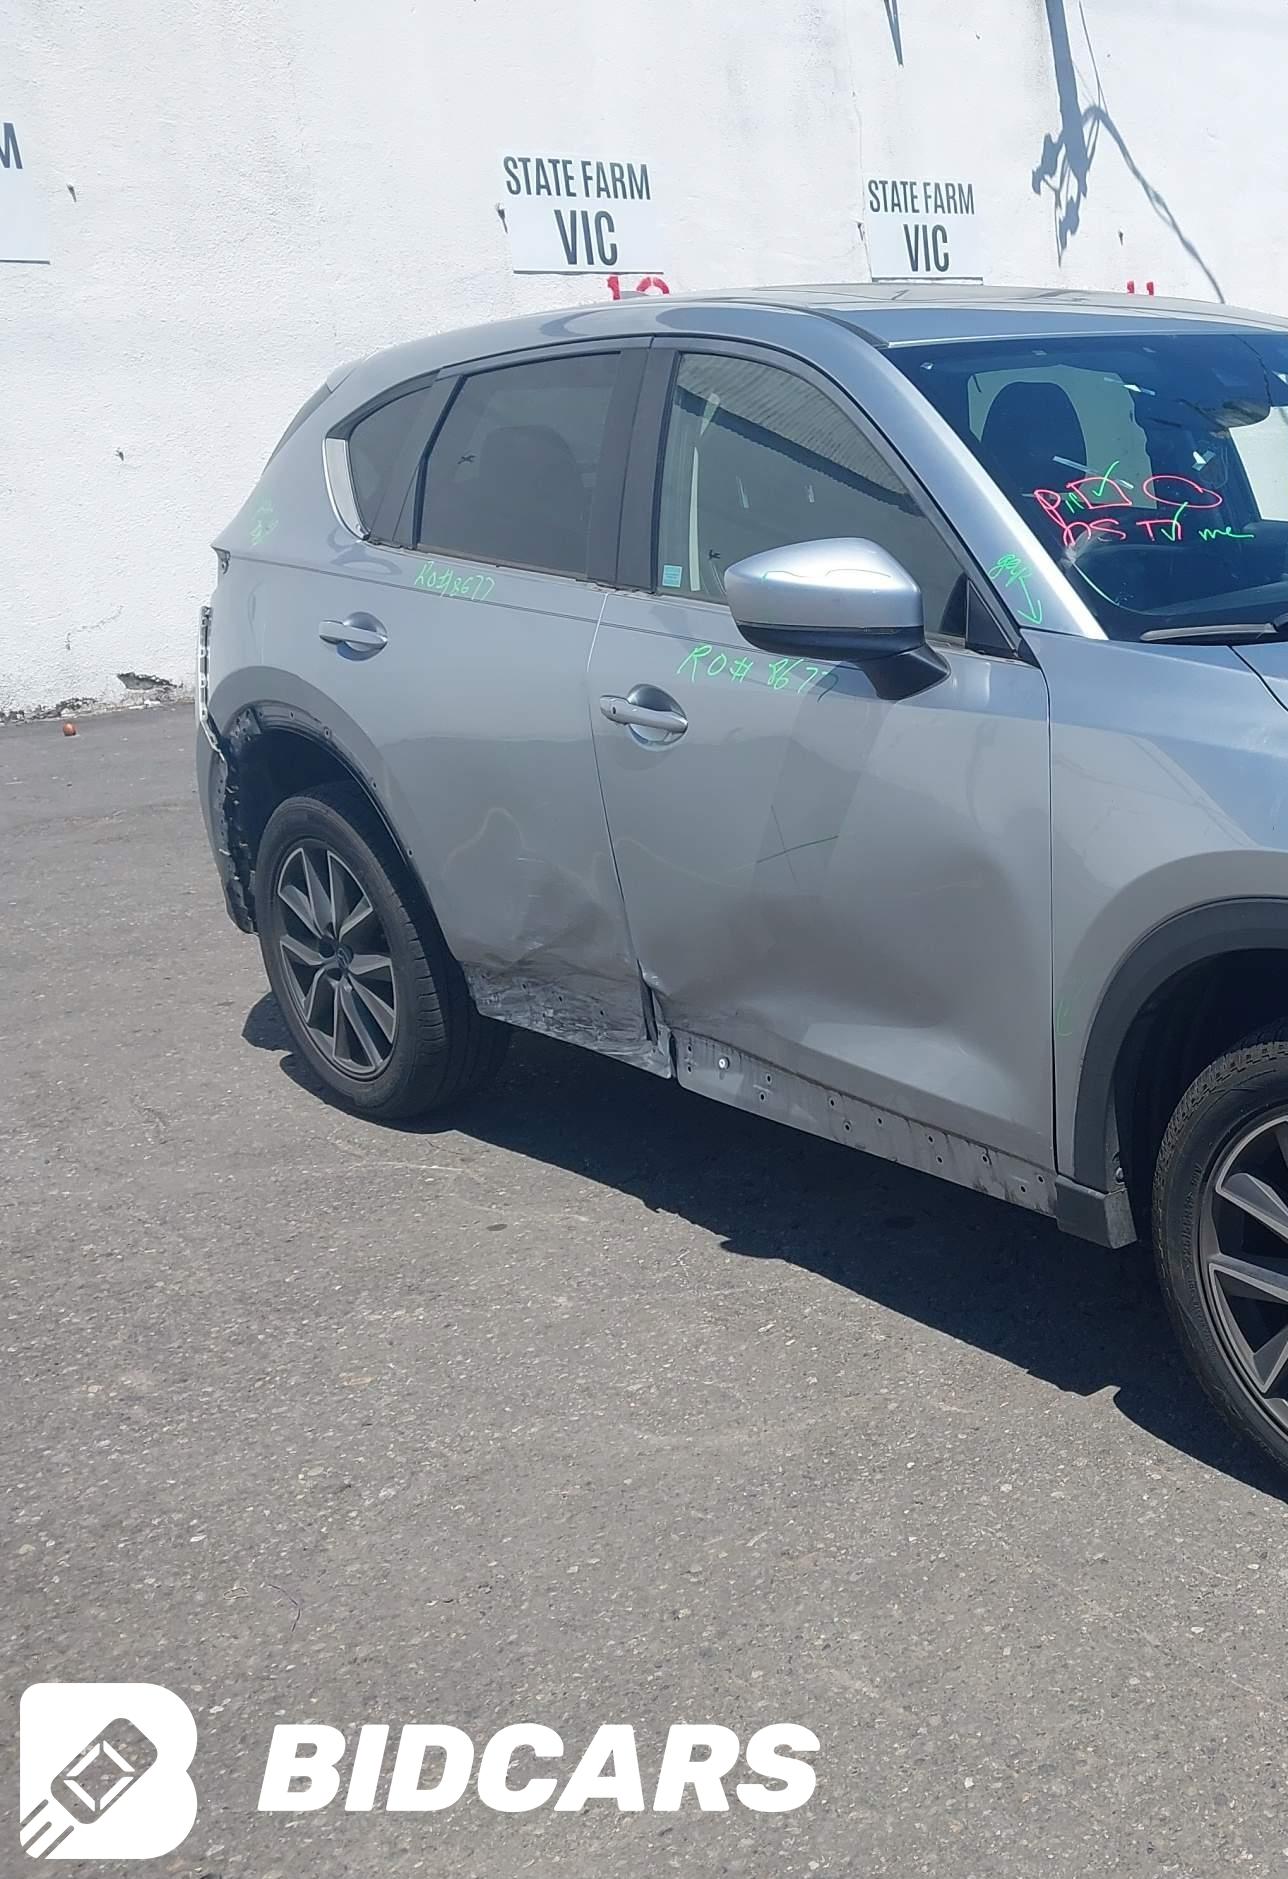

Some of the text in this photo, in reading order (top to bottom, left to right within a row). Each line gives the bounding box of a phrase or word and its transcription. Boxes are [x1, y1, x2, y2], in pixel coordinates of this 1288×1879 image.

[503, 156, 651, 200] STATE FARM
[867, 179, 975, 215] STATE FARM
[554, 209, 618, 266] VIC
[903, 224, 949, 272] VIC
